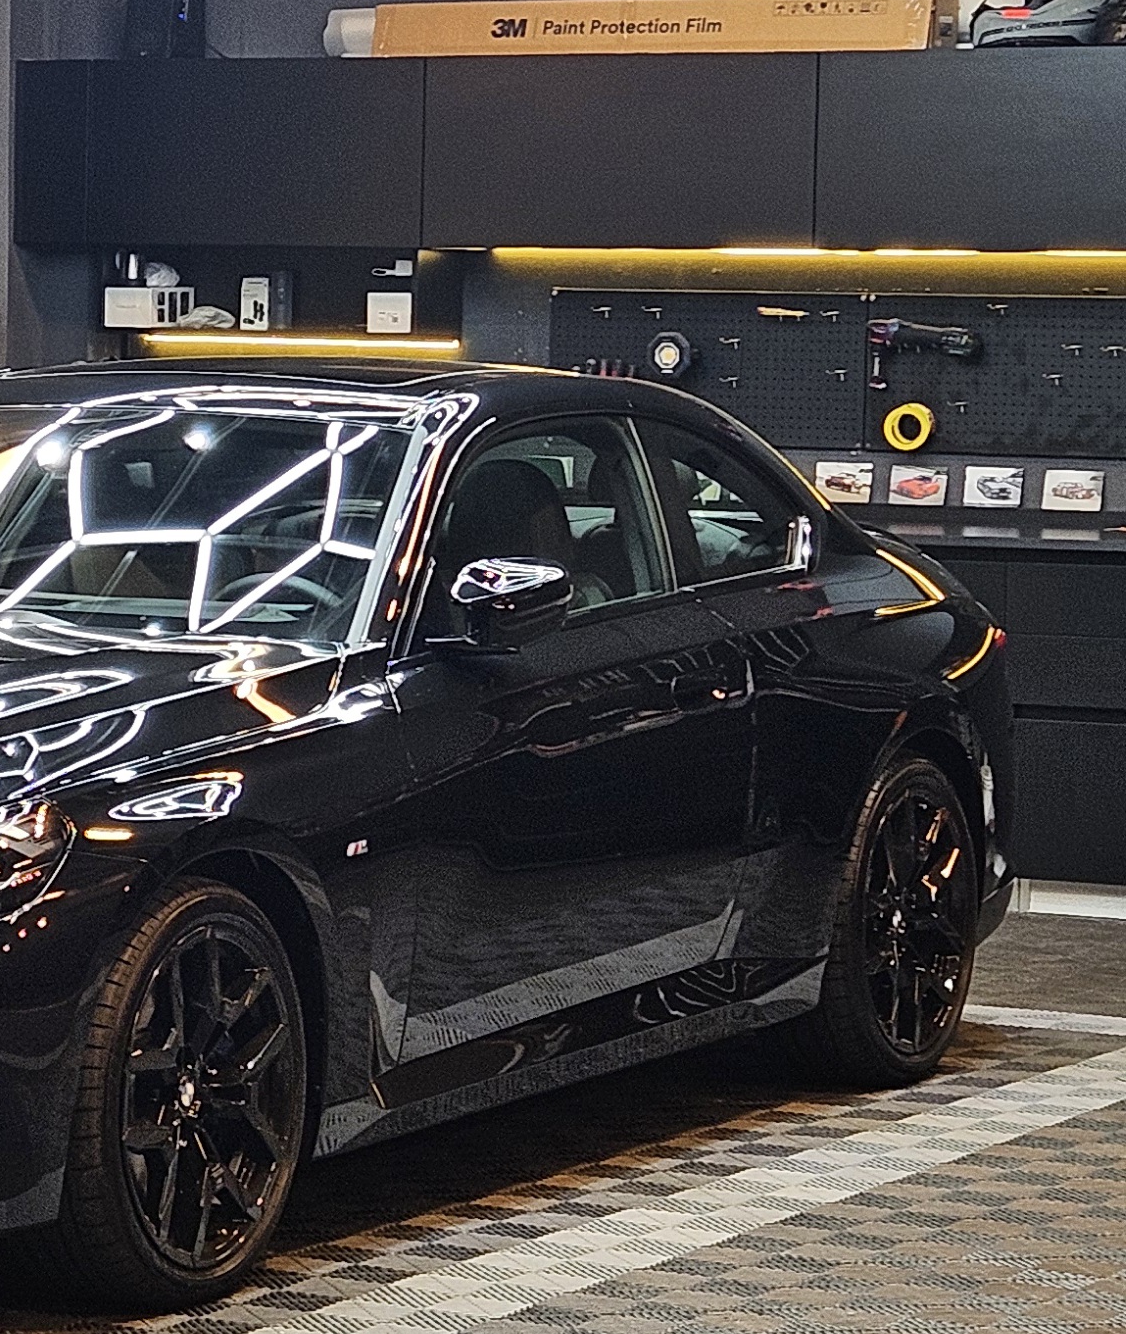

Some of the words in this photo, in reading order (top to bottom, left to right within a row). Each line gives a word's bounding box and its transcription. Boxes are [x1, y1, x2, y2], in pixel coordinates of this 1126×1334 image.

[490, 18, 527, 38] 3M
[542, 20, 585, 35] Paint
[590, 19, 680, 35] Protection
[685, 18, 722, 33] Film
